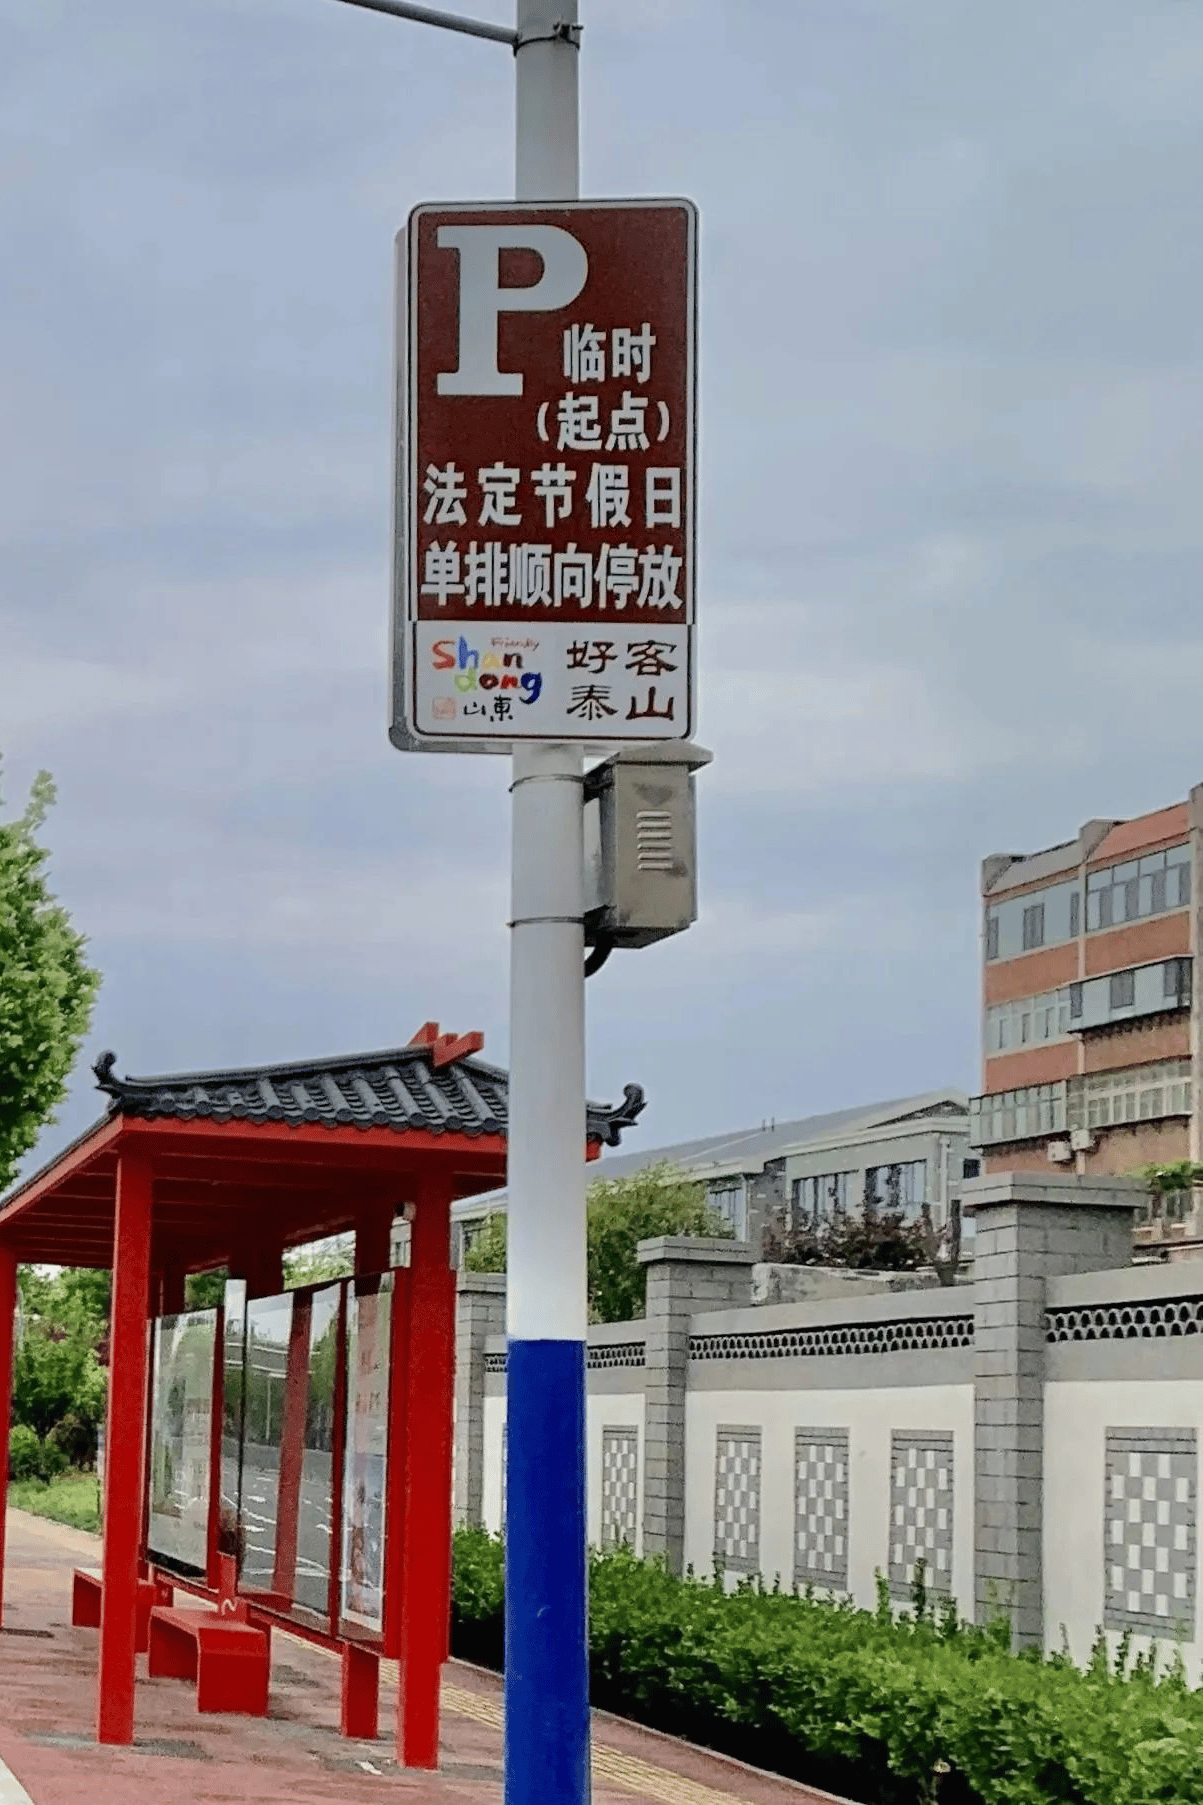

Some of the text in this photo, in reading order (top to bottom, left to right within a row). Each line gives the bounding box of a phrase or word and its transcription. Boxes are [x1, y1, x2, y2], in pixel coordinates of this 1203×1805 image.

[437, 224, 589, 396] P
[563, 322, 657, 384] 临时
[536, 390, 671, 452] (起点)
[423, 461, 682, 529] 法定节假日
[420, 540, 684, 611] 单排顺向停放
[566, 639, 679, 677] 好客
[566, 684, 676, 722] 泰山
